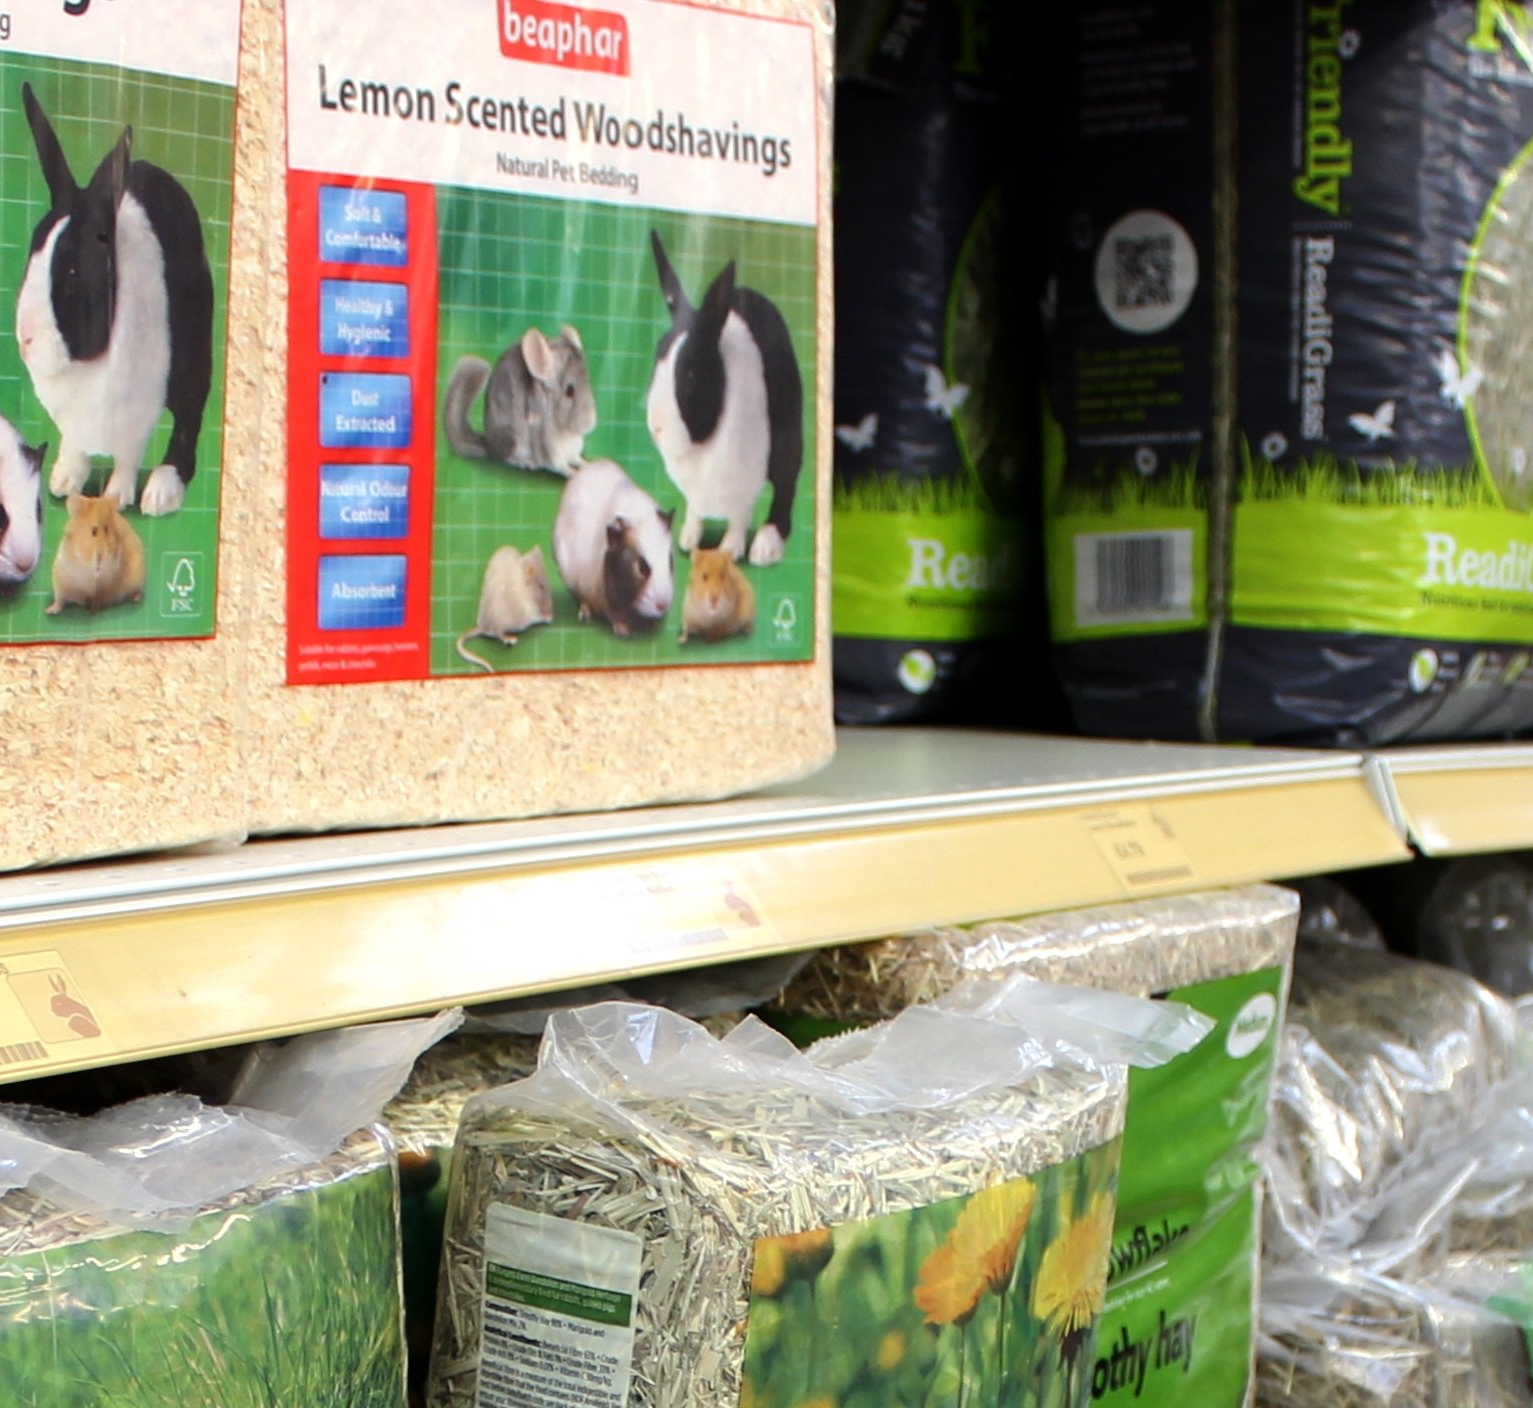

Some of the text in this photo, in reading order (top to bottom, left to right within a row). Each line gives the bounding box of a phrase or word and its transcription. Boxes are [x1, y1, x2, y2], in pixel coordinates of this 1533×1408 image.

[503, 0, 623, 61] beaphar
[318, 64, 792, 175] Lemon Scented Woodshavings
[495, 152, 639, 194] Natural Pet Bedding
[325, 229, 402, 253] Comfortable
[351, 389, 380, 406] Dust
[335, 415, 396, 433] Extracted
[340, 506, 391, 524] Control
[331, 581, 397, 600] Absorbent
[1155, 1310, 1196, 1373] hay
